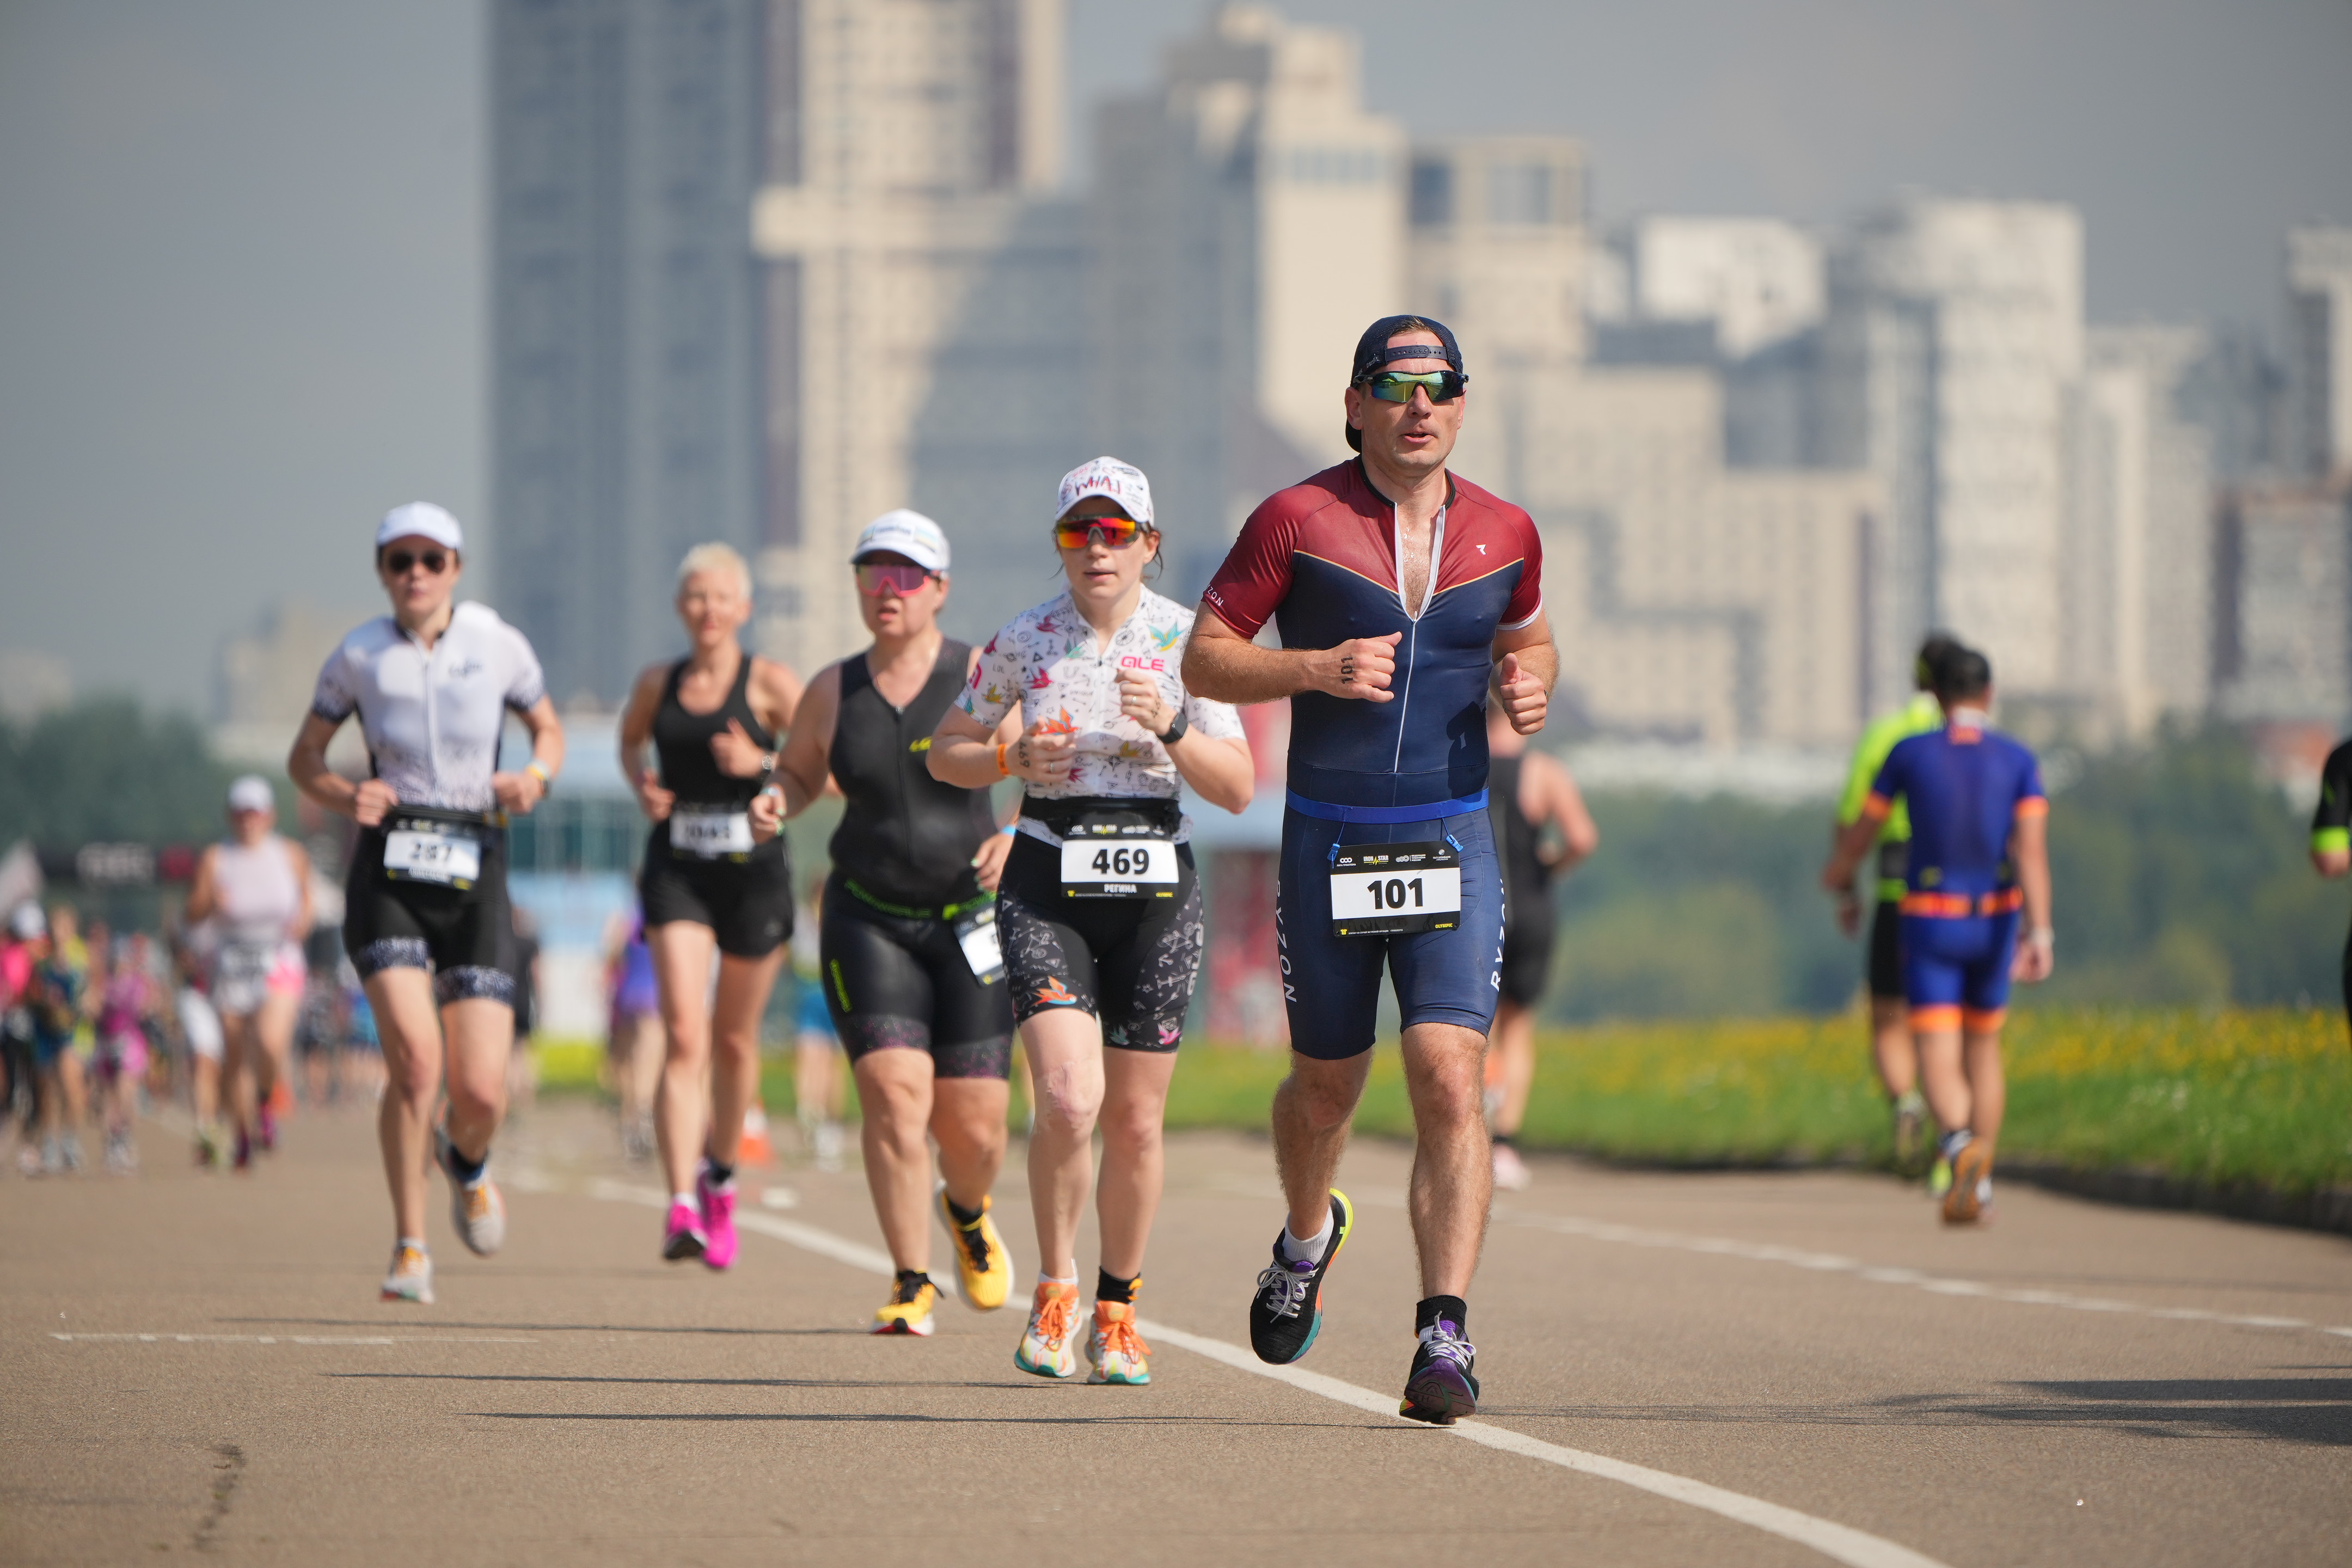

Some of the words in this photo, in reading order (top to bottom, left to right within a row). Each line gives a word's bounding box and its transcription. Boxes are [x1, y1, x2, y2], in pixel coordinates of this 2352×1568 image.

[1340, 657, 1353, 684] 101
[1092, 848, 1149, 875] 469
[1104, 884, 1137, 893] РЕГИНА
[1367, 877, 1424, 910] 101
